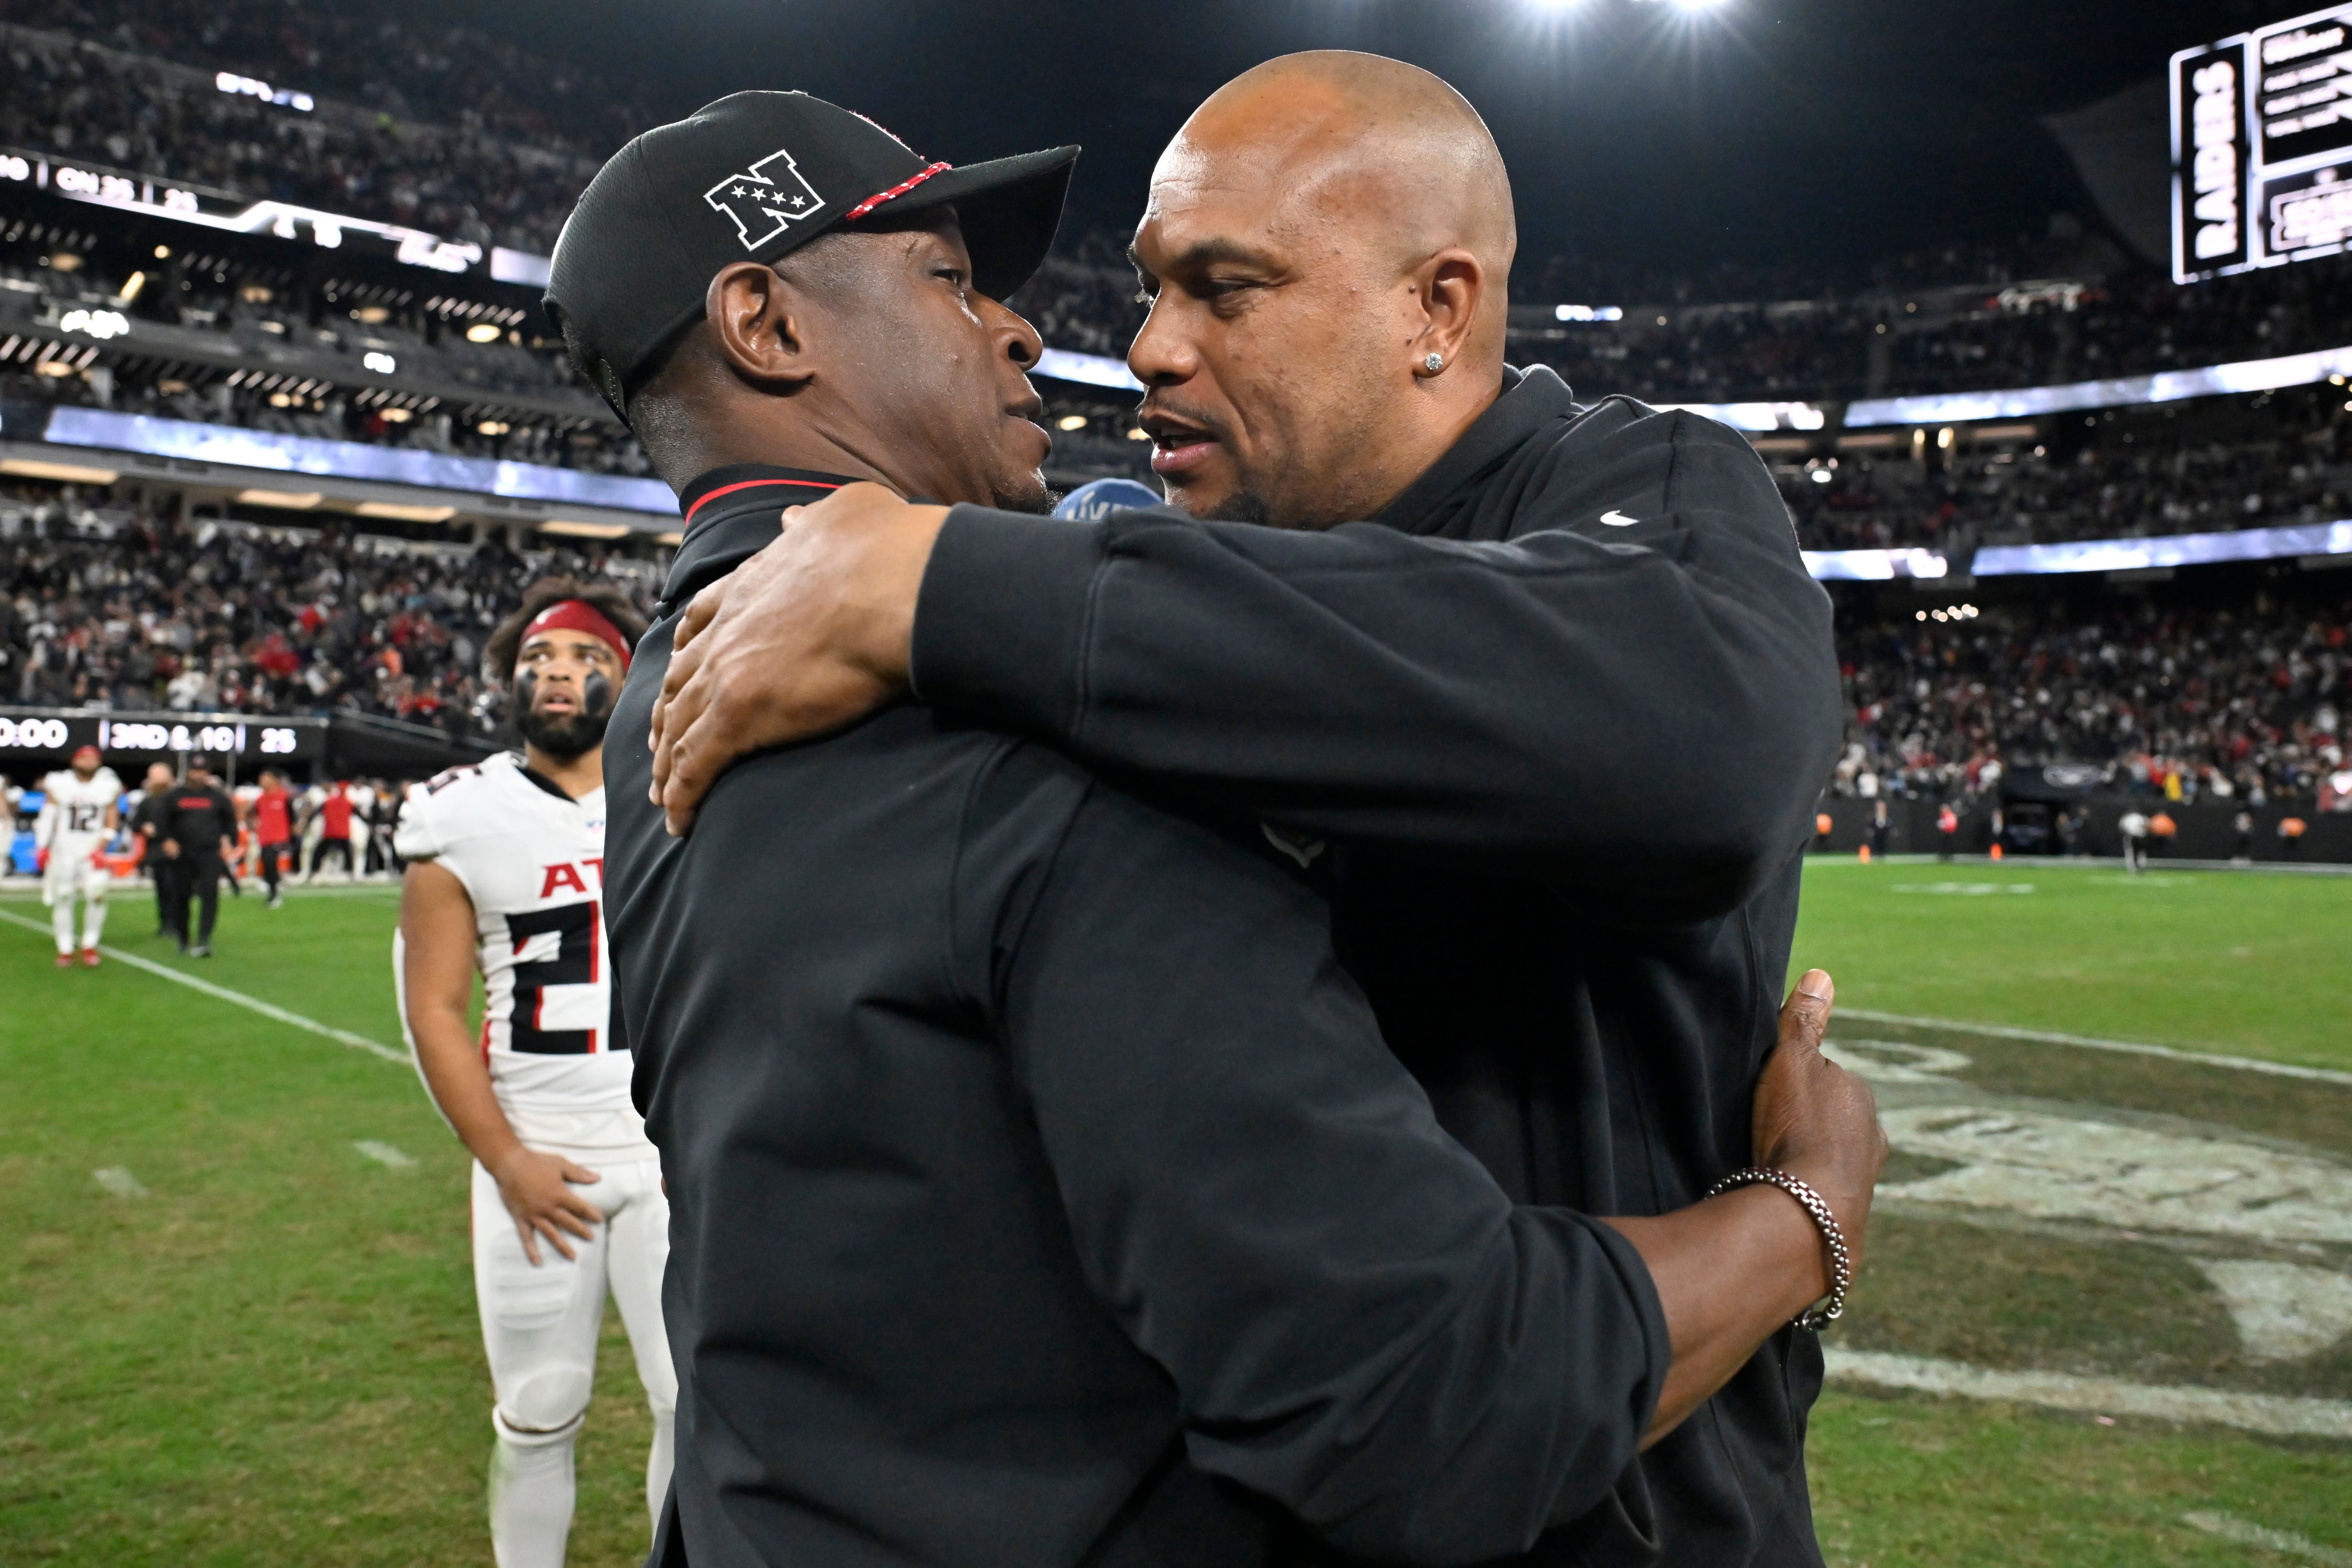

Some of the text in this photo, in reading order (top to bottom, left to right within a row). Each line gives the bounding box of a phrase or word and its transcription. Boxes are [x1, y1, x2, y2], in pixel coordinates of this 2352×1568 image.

[2194, 61, 2236, 259] RAIDERS
[703, 148, 826, 252] N
[111, 723, 169, 750] 3RD
[201, 726, 234, 752] 10
[261, 728, 297, 753] 25
[68, 803, 98, 832] 12
